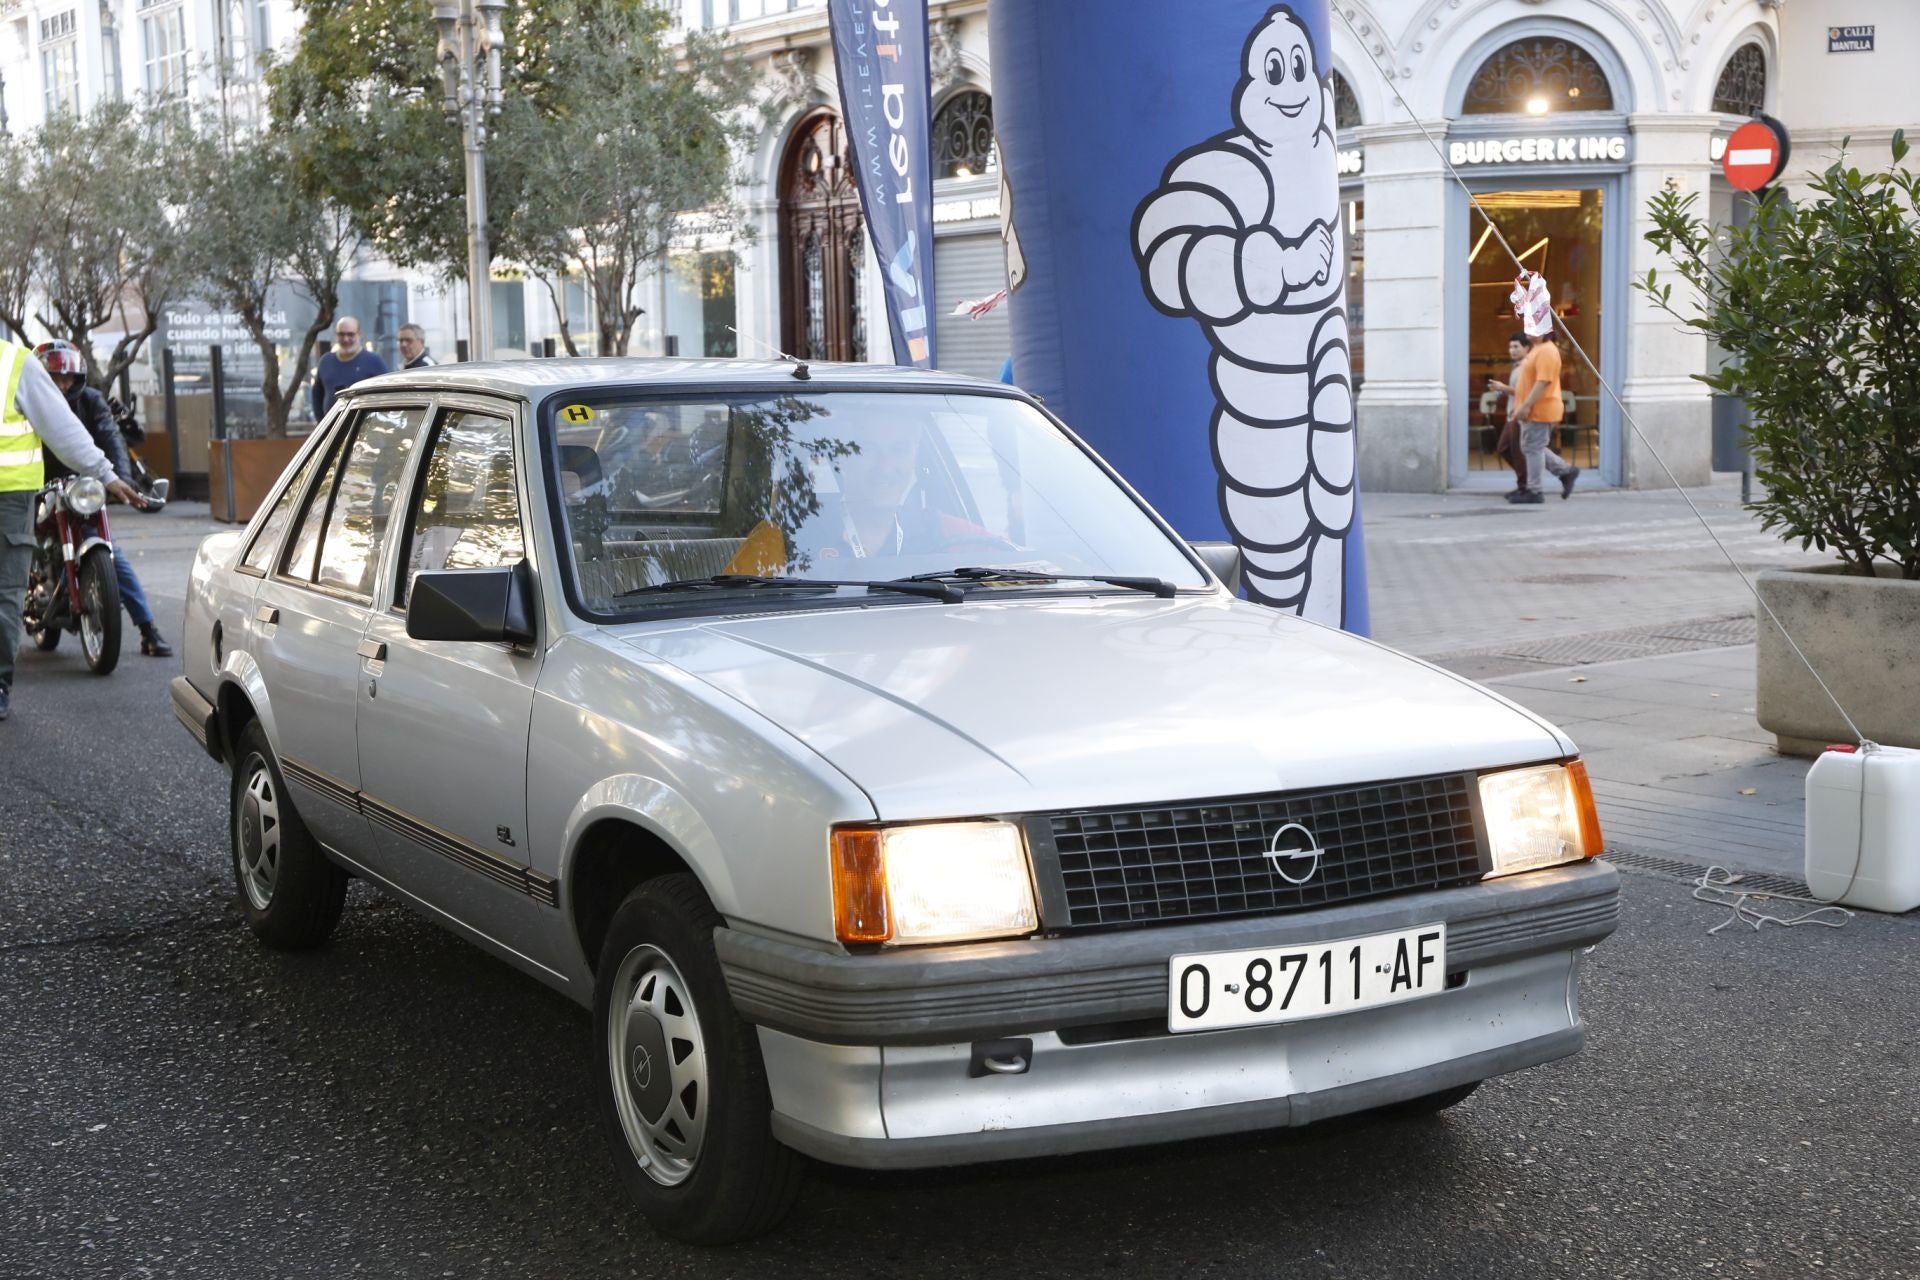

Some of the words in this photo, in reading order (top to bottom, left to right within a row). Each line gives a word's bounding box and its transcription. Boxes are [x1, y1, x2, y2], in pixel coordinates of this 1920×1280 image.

[1843, 26, 1874, 37] CALLE
[1831, 41, 1872, 51] MANTILLA
[1450, 138, 1555, 165] BURGER
[1556, 137, 1626, 161] KING
[165, 311, 201, 325] Todo
[203, 314, 220, 325] es
[166, 327, 220, 340] cuando
[184, 342, 232, 356] miso
[567, 407, 589, 421] H
